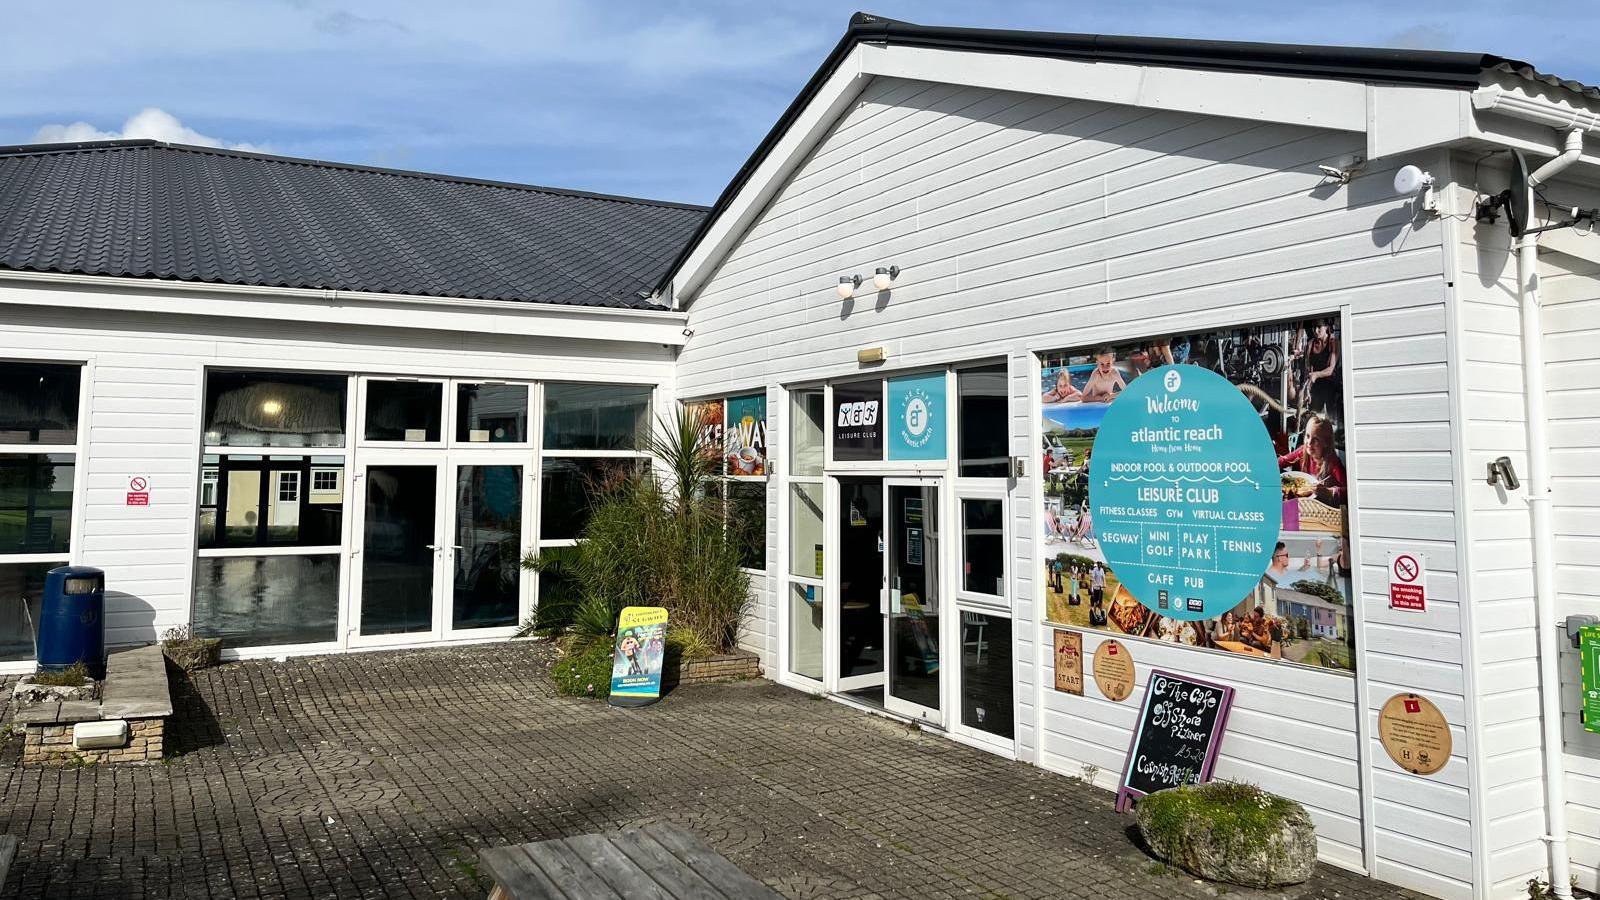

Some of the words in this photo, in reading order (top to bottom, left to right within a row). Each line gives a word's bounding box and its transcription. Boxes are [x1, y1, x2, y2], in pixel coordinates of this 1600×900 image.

[1145, 394, 1200, 414] Welcome
[901, 430, 920, 448] atlantic
[920, 426, 933, 446] reach
[1131, 426, 1180, 442] atlantic
[1184, 424, 1222, 440] reach
[1110, 463, 1142, 472] INDOOR
[1144, 463, 1166, 472] POOL
[1168, 463, 1174, 472] &
[1176, 463, 1223, 473] OUTDOOR
[1224, 462, 1251, 472] POOL
[1138, 488, 1183, 502] LEISURE
[1186, 488, 1219, 503] CLUB
[1100, 506, 1126, 516] FITNESS
[1126, 508, 1158, 517] CLASSES
[1166, 509, 1183, 518] GYM
[1192, 510, 1226, 520] VIRTUAL
[1227, 512, 1264, 521] CLASSES
[1102, 532, 1140, 544] SEGWAY
[1150, 532, 1170, 542] MINI
[1183, 532, 1209, 544] PLAY
[1146, 546, 1174, 557] GOLF
[1182, 548, 1211, 560] PARK
[1222, 540, 1262, 554] TENNIS
[1148, 573, 1174, 585] CAFE
[1184, 576, 1204, 588] PUB
[1058, 674, 1080, 684] START
[1168, 682, 1188, 702] The
[1190, 688, 1216, 714] Cafe
[1402, 750, 1410, 760] H
[1138, 755, 1169, 784] Cornish
